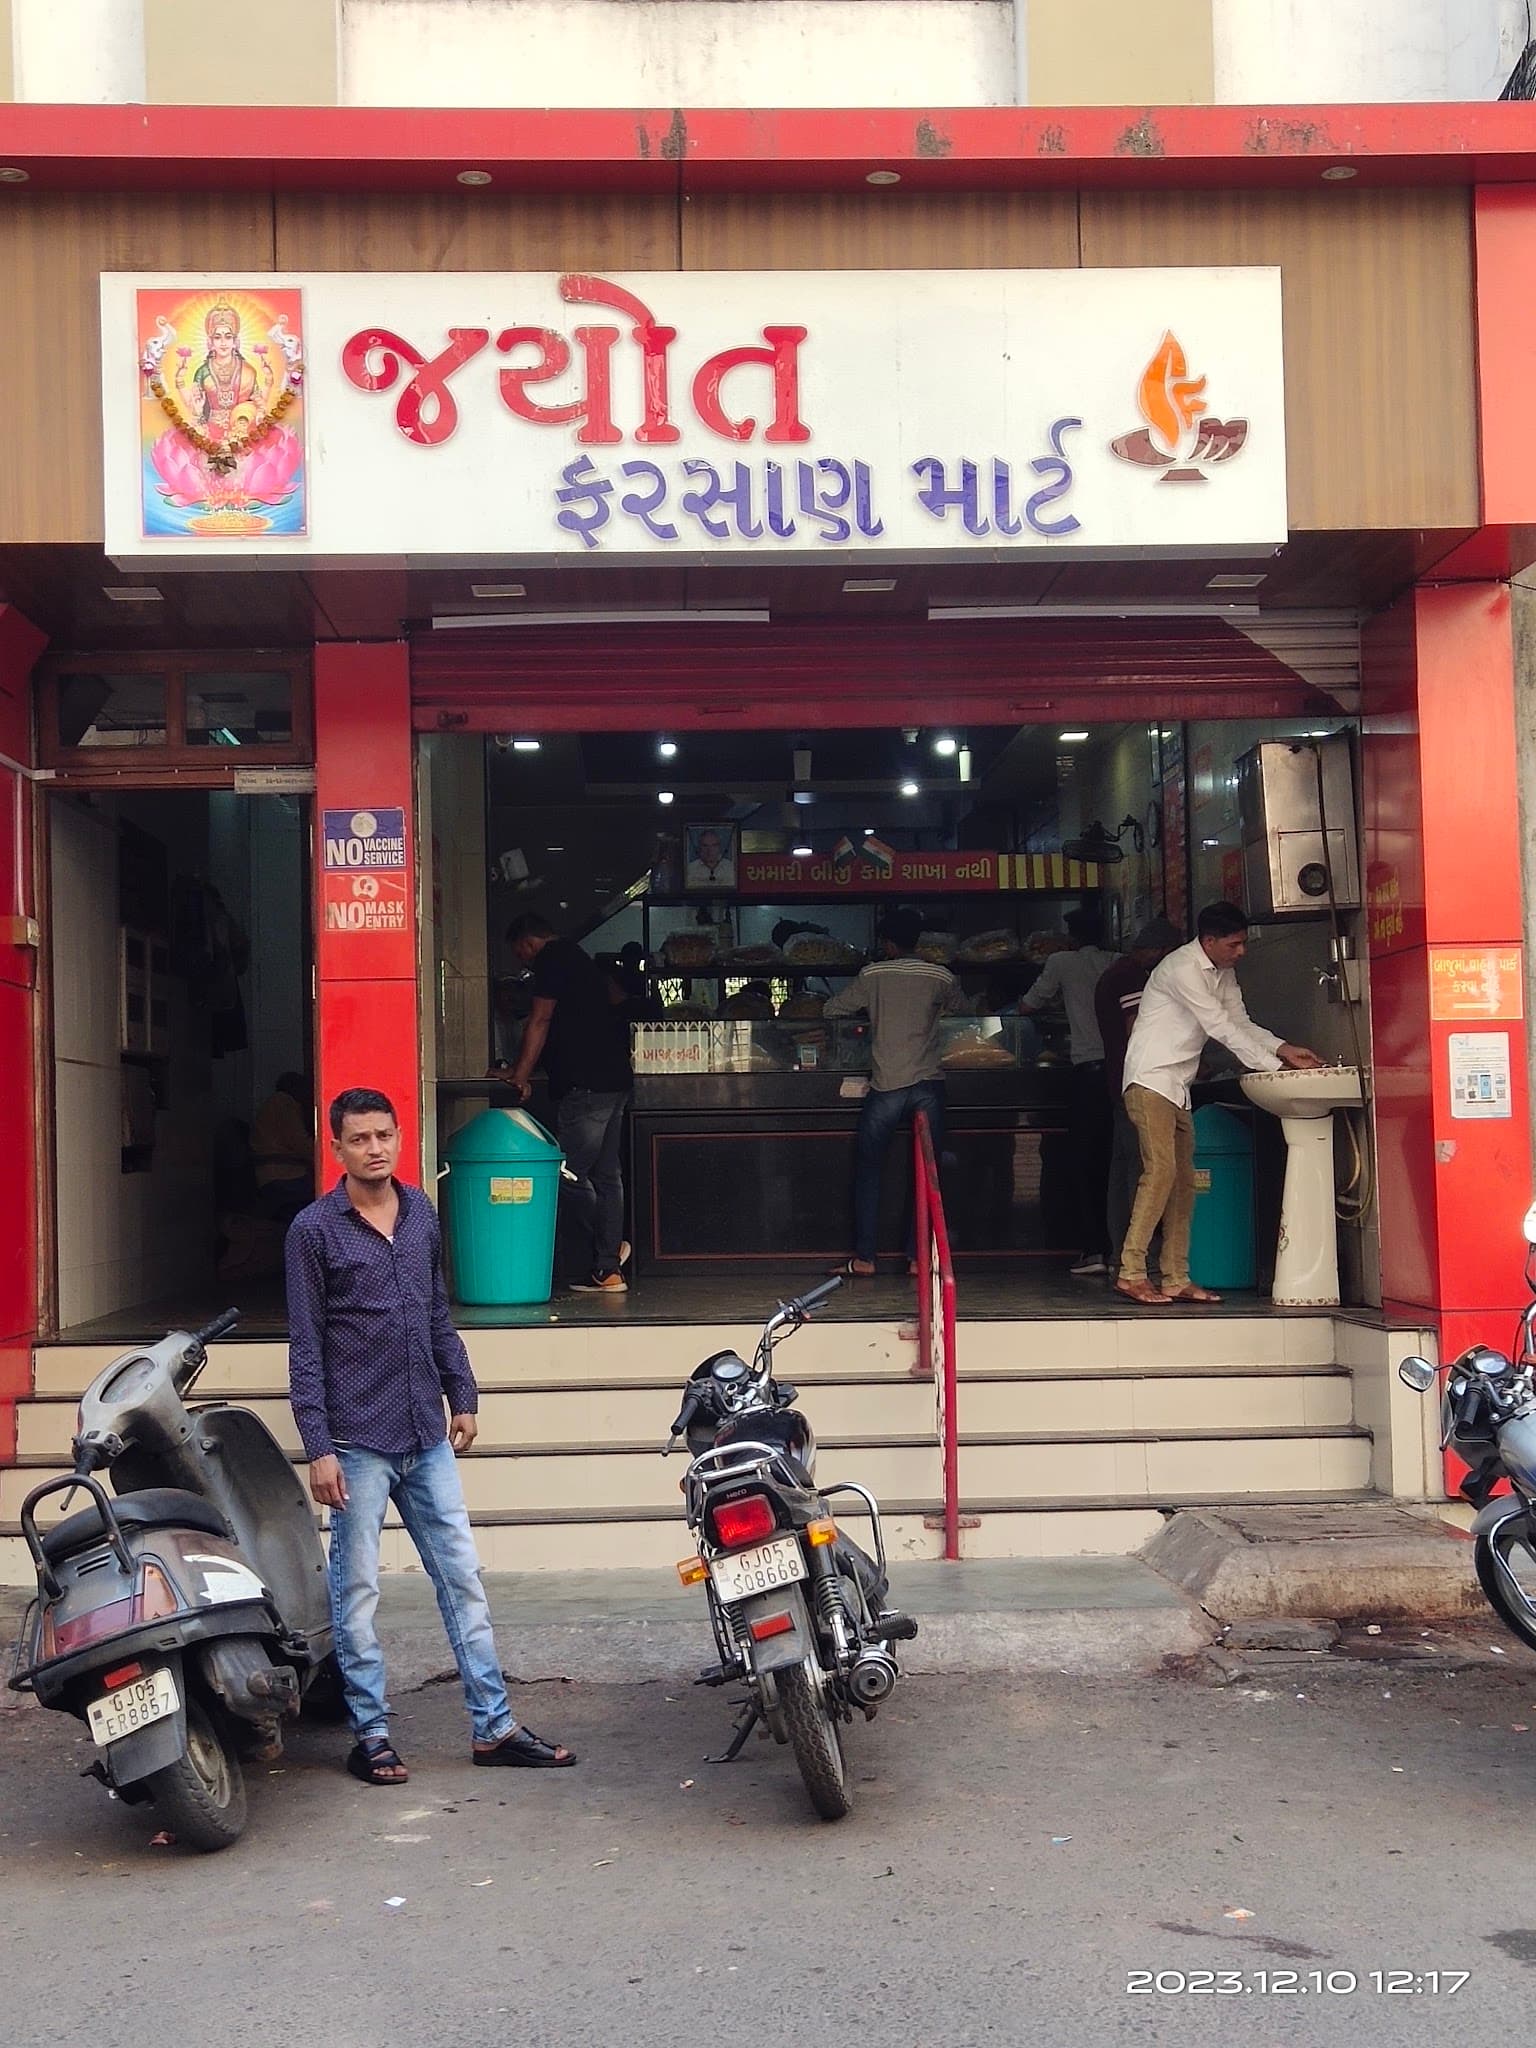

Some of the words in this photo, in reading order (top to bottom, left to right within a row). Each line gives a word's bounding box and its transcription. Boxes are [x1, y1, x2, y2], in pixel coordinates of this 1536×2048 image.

[554, 452, 888, 550] ફરસાણ
[911, 416, 1086, 538] માર્ટ
[327, 838, 364, 866] NO
[364, 837, 403, 851] VACCINE
[364, 851, 404, 865] SERVICE
[746, 860, 802, 881] અમારી
[902, 863, 946, 880] શાખા
[955, 857, 991, 879] નથી
[327, 901, 365, 929] NO
[365, 900, 404, 915] MASK
[366, 914, 404, 929] ENTRY
[740, 1544, 784, 1571] GJ05
[733, 1560, 799, 1595] SQ8668
[113, 1678, 155, 1711] GJ05
[106, 1692, 170, 1736] ER8857
